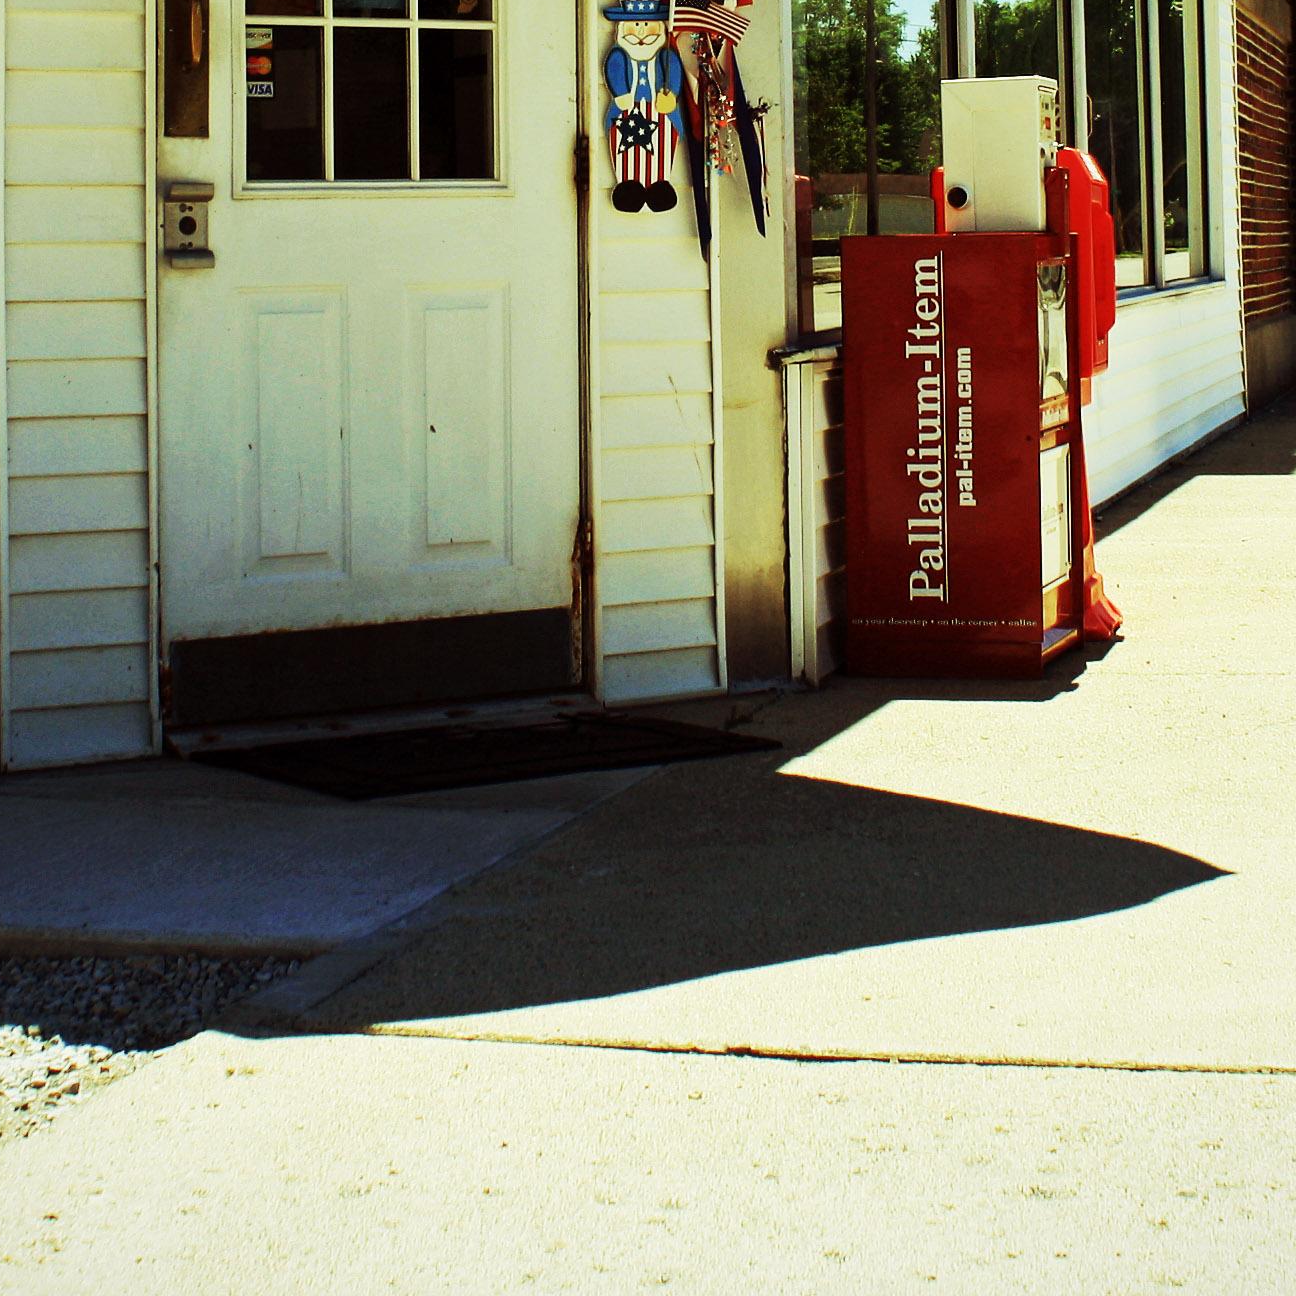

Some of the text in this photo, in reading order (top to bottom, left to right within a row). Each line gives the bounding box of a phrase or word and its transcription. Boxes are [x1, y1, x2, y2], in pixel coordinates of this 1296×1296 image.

[247, 84, 272, 95] VISA
[906, 255, 944, 602] Palladium-Item
[956, 347, 977, 507] pal-item.com
